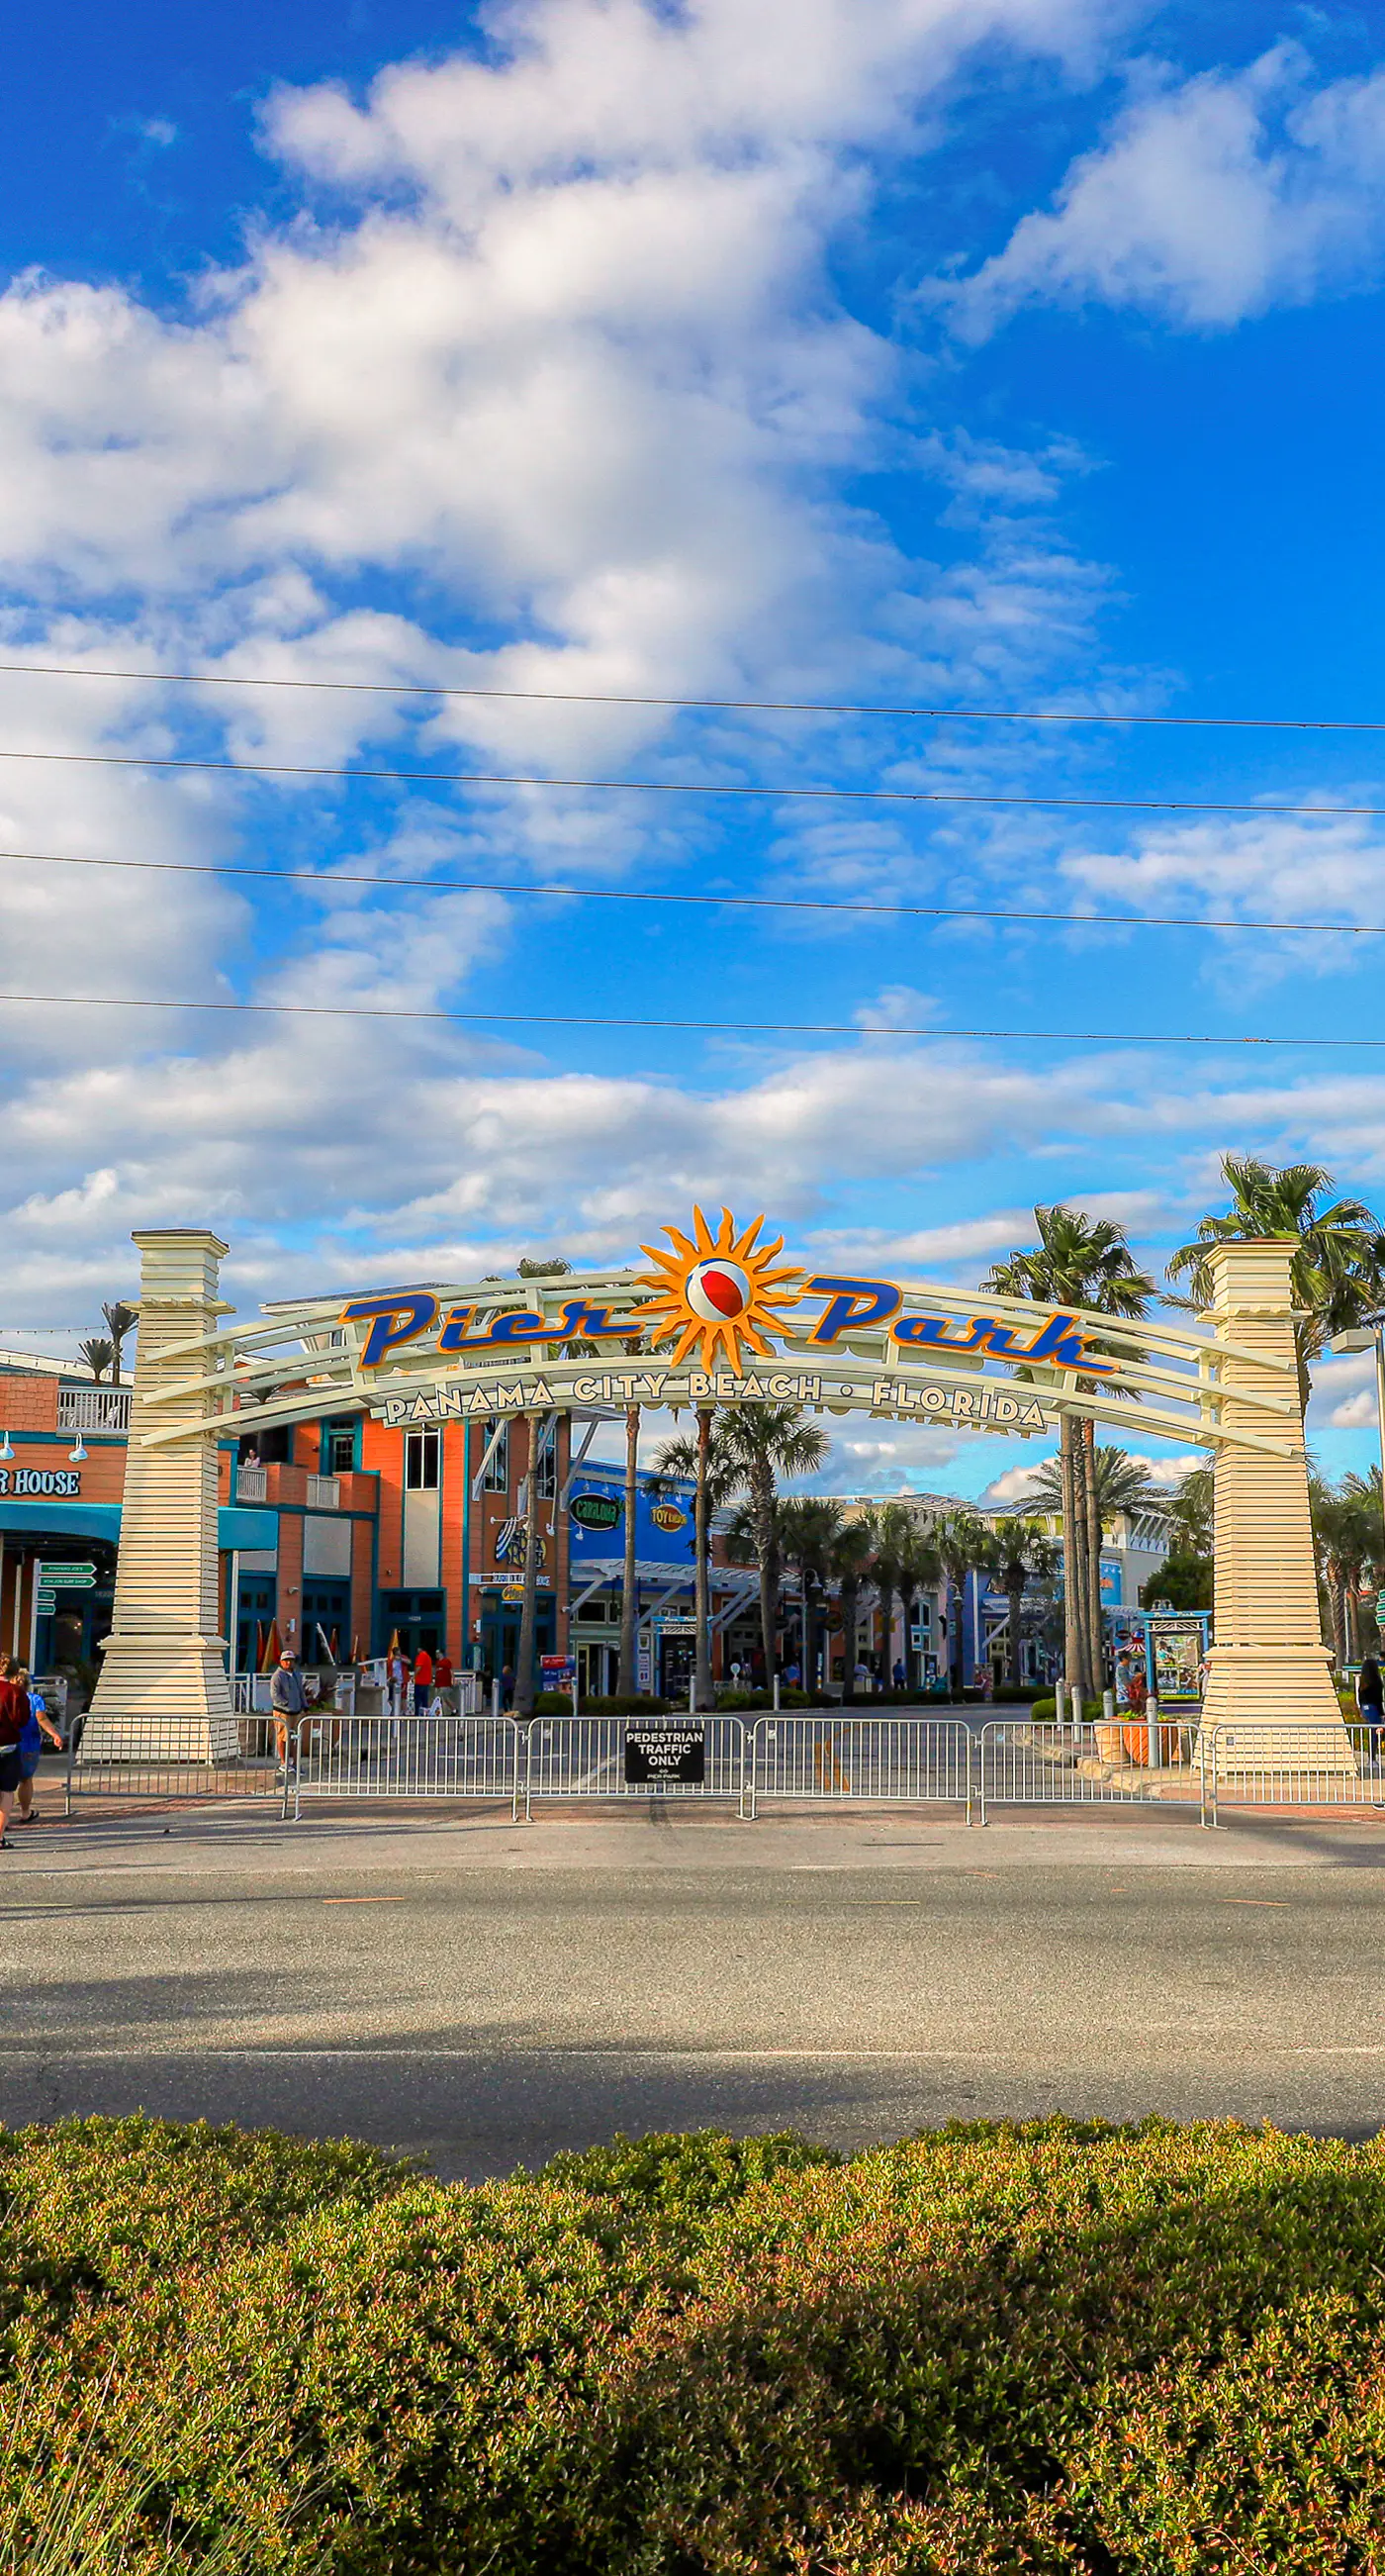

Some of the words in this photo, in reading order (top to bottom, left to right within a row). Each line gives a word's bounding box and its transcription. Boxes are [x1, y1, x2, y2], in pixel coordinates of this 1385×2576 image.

[337, 1290, 647, 1373] Pier
[798, 1274, 1121, 1377] Park
[385, 1378, 555, 1425] PANAMA
[573, 1373, 669, 1402] CITY
[689, 1371, 821, 1401] BEACH
[872, 1379, 1046, 1430] FLORIDA
[13, 1469, 80, 1495] HOUSE
[626, 1732, 703, 1743] PEDESTRIAN
[638, 1744, 692, 1755] TRAFFIC
[648, 1755, 682, 1766] ONLY
